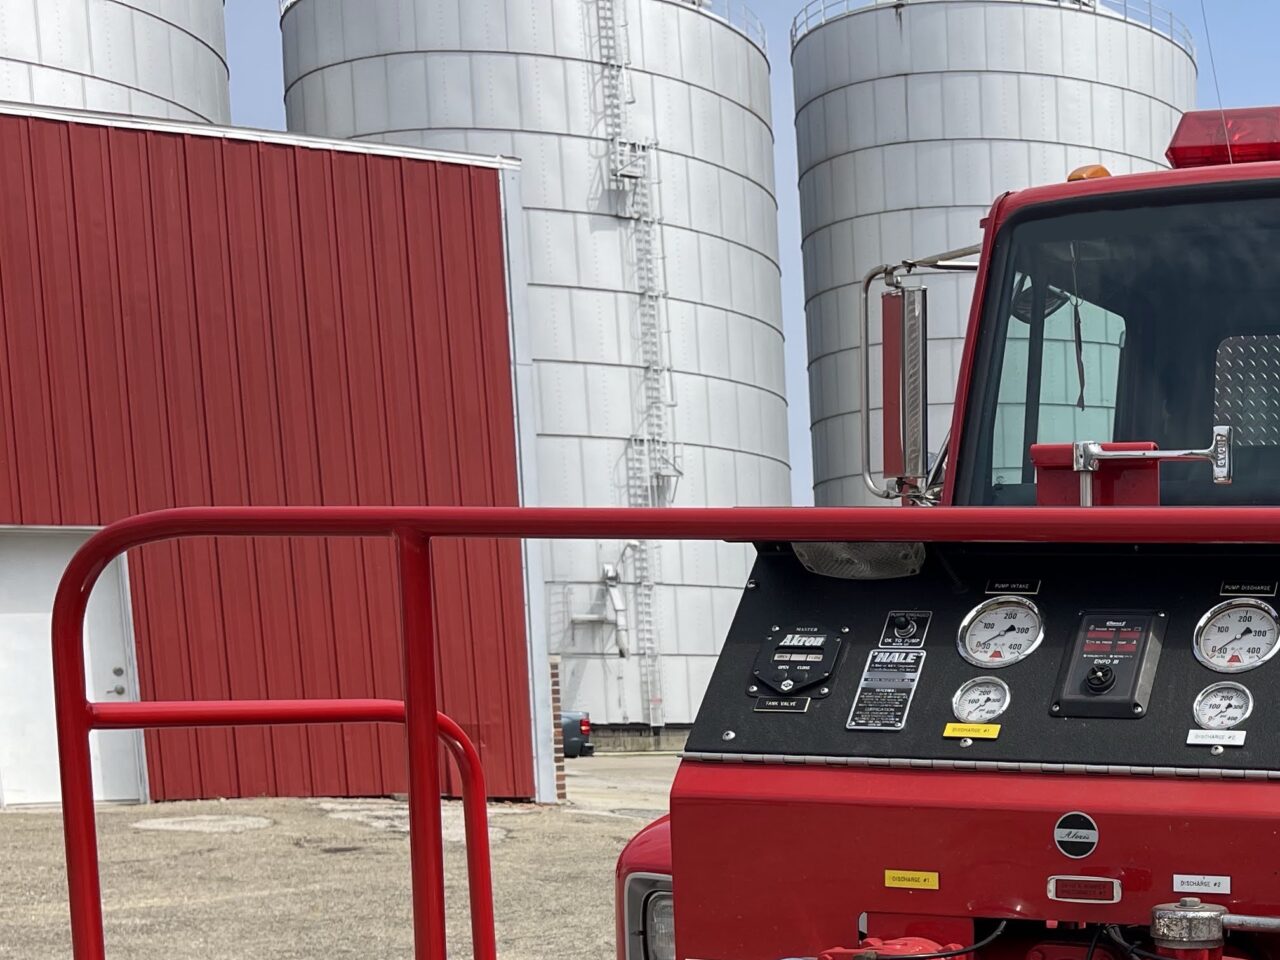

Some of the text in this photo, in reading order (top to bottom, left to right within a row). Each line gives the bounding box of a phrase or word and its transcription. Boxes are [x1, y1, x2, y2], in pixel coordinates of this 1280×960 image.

[1004, 612, 1018, 620] 200
[779, 634, 826, 647] Akron
[874, 652, 918, 663] HALE
[1180, 880, 1211, 888] DISCHARGE
